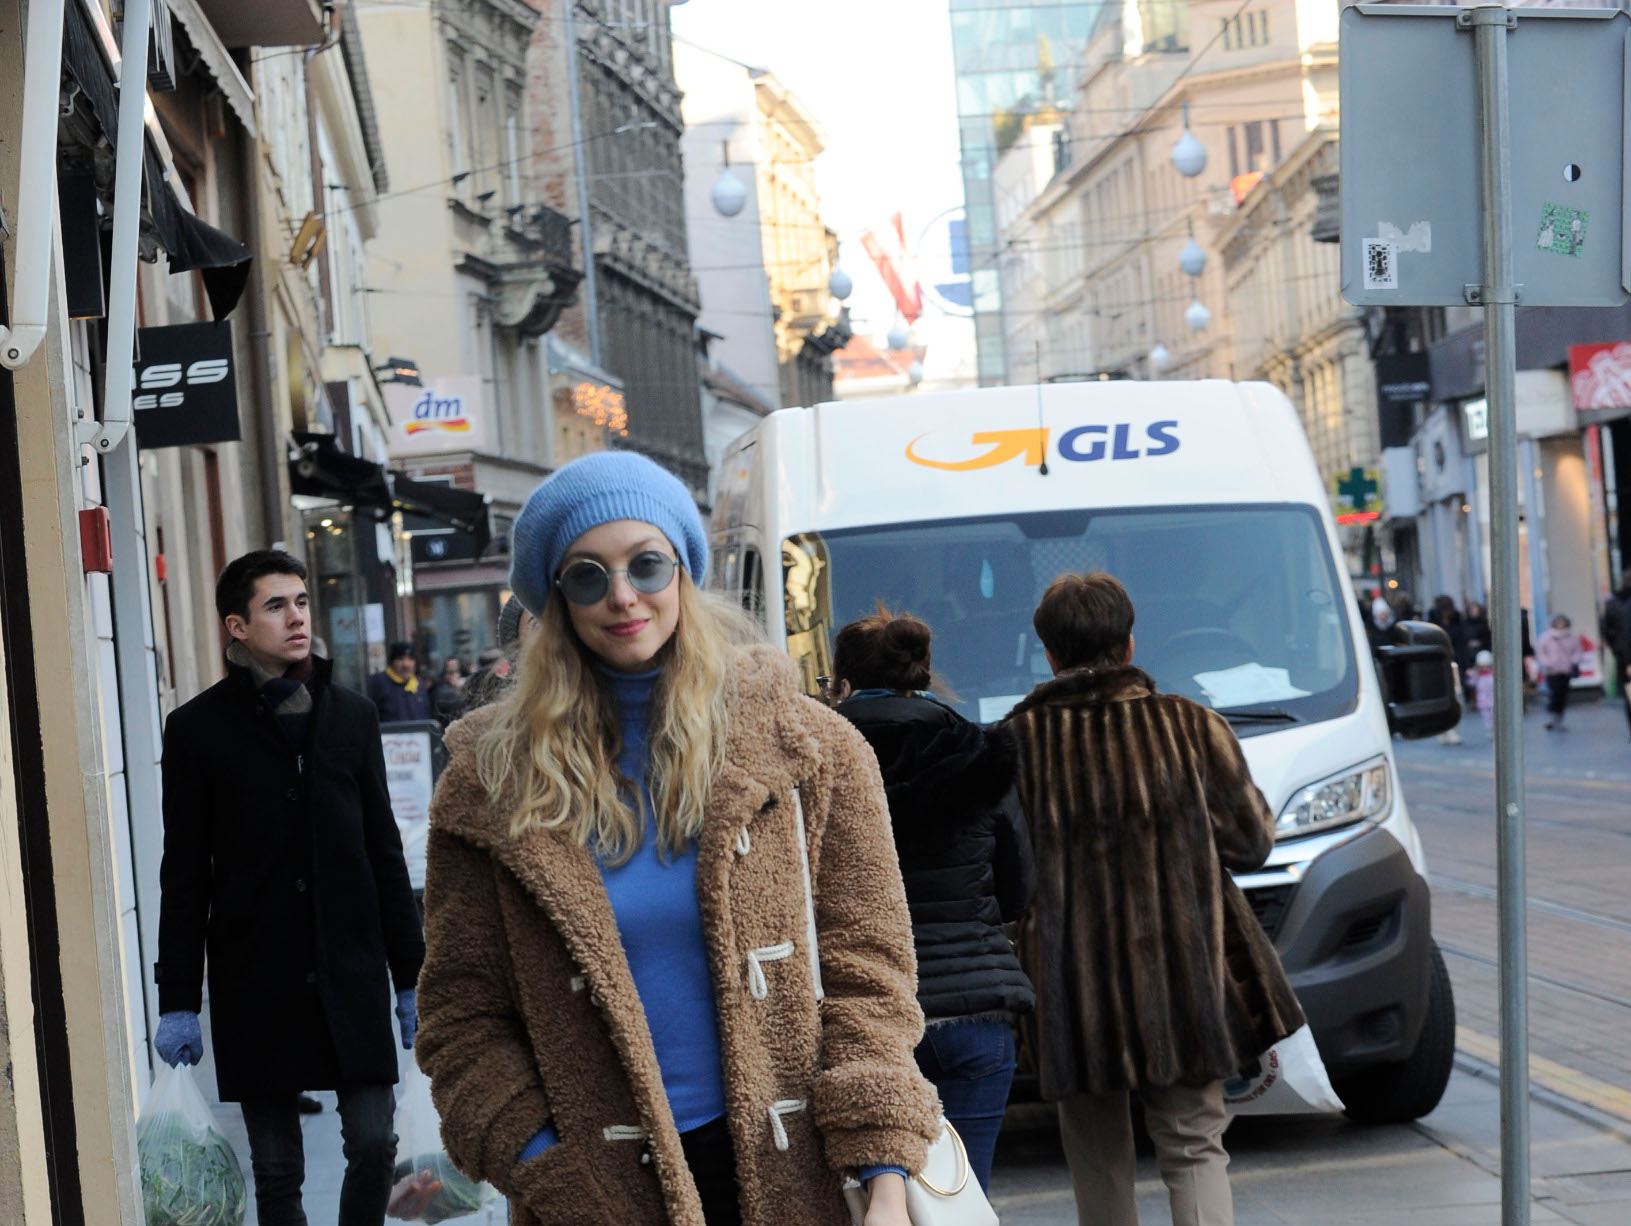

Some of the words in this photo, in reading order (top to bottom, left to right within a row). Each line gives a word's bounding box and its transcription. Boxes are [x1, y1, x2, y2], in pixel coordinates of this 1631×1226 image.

[132, 358, 229, 390] SS
[133, 392, 185, 410] ES
[415, 392, 461, 418] dm
[1057, 420, 1180, 462] GLS
